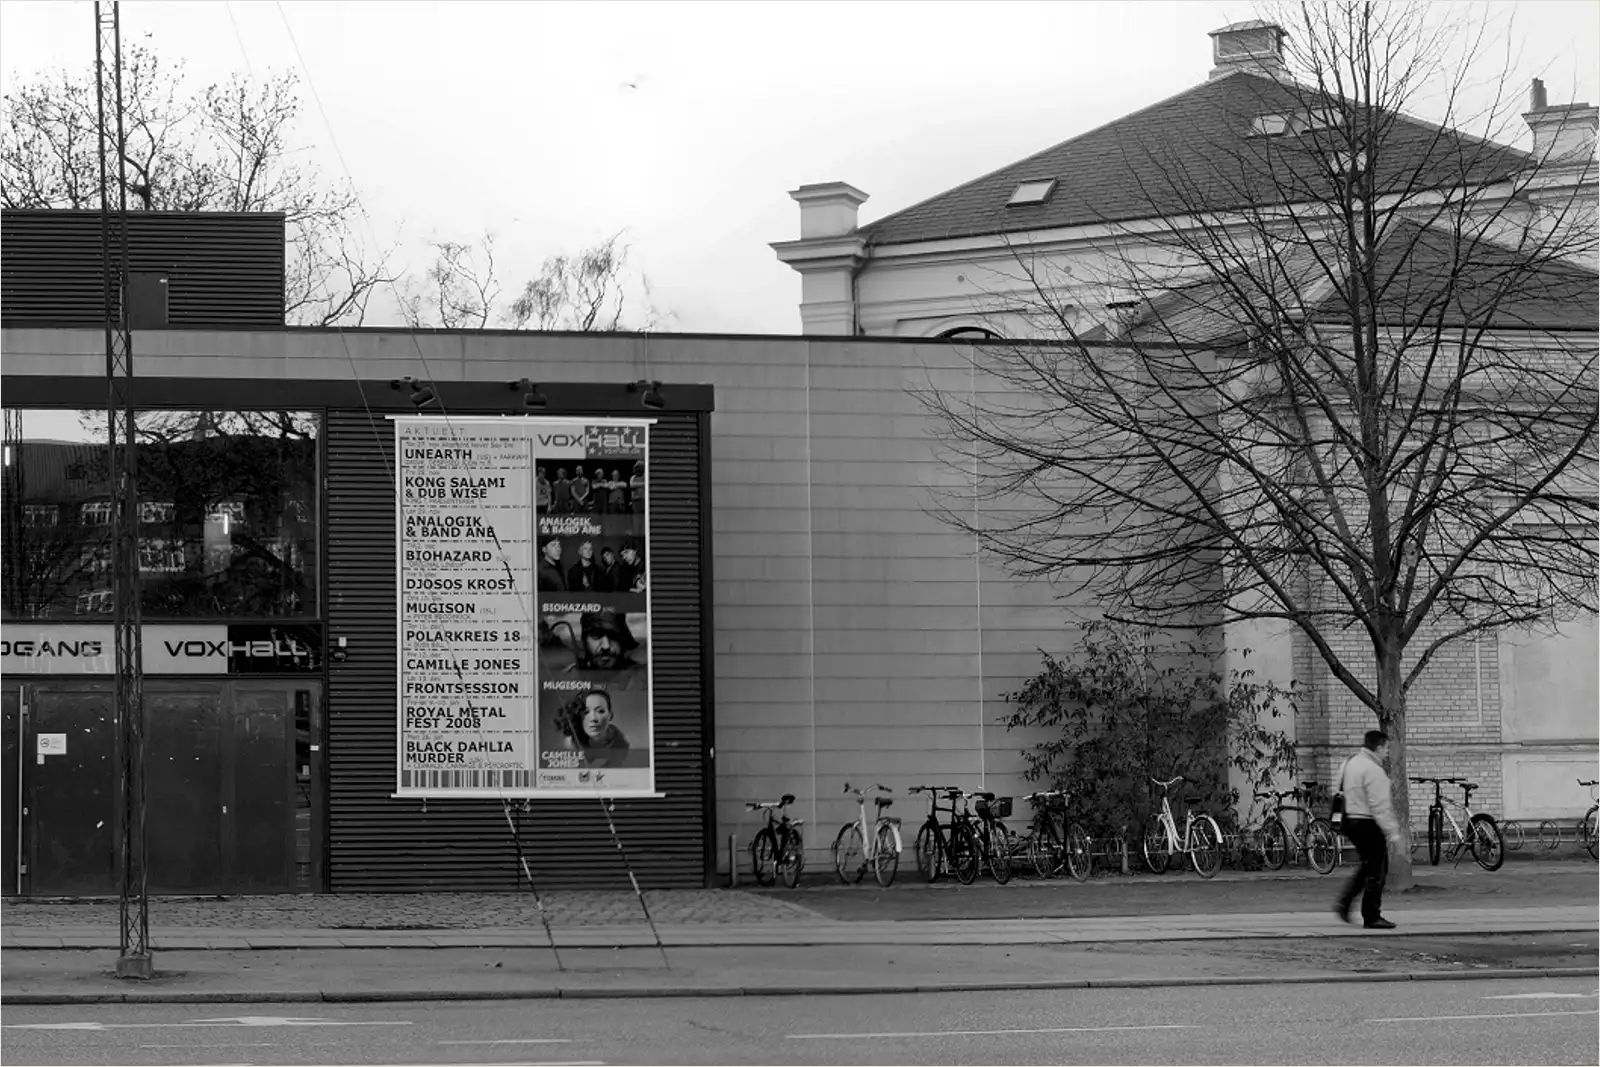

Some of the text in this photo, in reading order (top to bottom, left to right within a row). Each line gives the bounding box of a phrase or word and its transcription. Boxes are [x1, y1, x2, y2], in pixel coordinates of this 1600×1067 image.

[405, 448, 472, 460] UNEARTH
[405, 477, 506, 488] KONG SALAMI
[405, 488, 488, 498] & DUB WISE
[406, 515, 482, 527] ANALOGIK
[539, 516, 592, 526] ANALOGIK
[406, 527, 416, 538] &
[421, 527, 461, 538] BAND
[552, 525, 579, 534] BAND
[406, 550, 492, 562] BIOHAZARD
[406, 579, 515, 590] DJOSOS KROST
[406, 603, 475, 614] MUGISON
[542, 603, 601, 613] BIOHAZARD
[407, 630, 498, 642] POLARKREIS
[504, 630, 521, 642] 18
[407, 659, 521, 670] CAMILLE JONES
[407, 683, 519, 694] FRONTSESSION
[543, 680, 592, 691] MUGISON
[407, 707, 506, 718] ROYAL METAL
[406, 718, 481, 729] FEST 2008
[407, 741, 514, 752] BLACK DAHLIA
[406, 753, 465, 763] MURDER
[541, 751, 585, 760] CAMILLE
[547, 759, 580, 768] JONES
